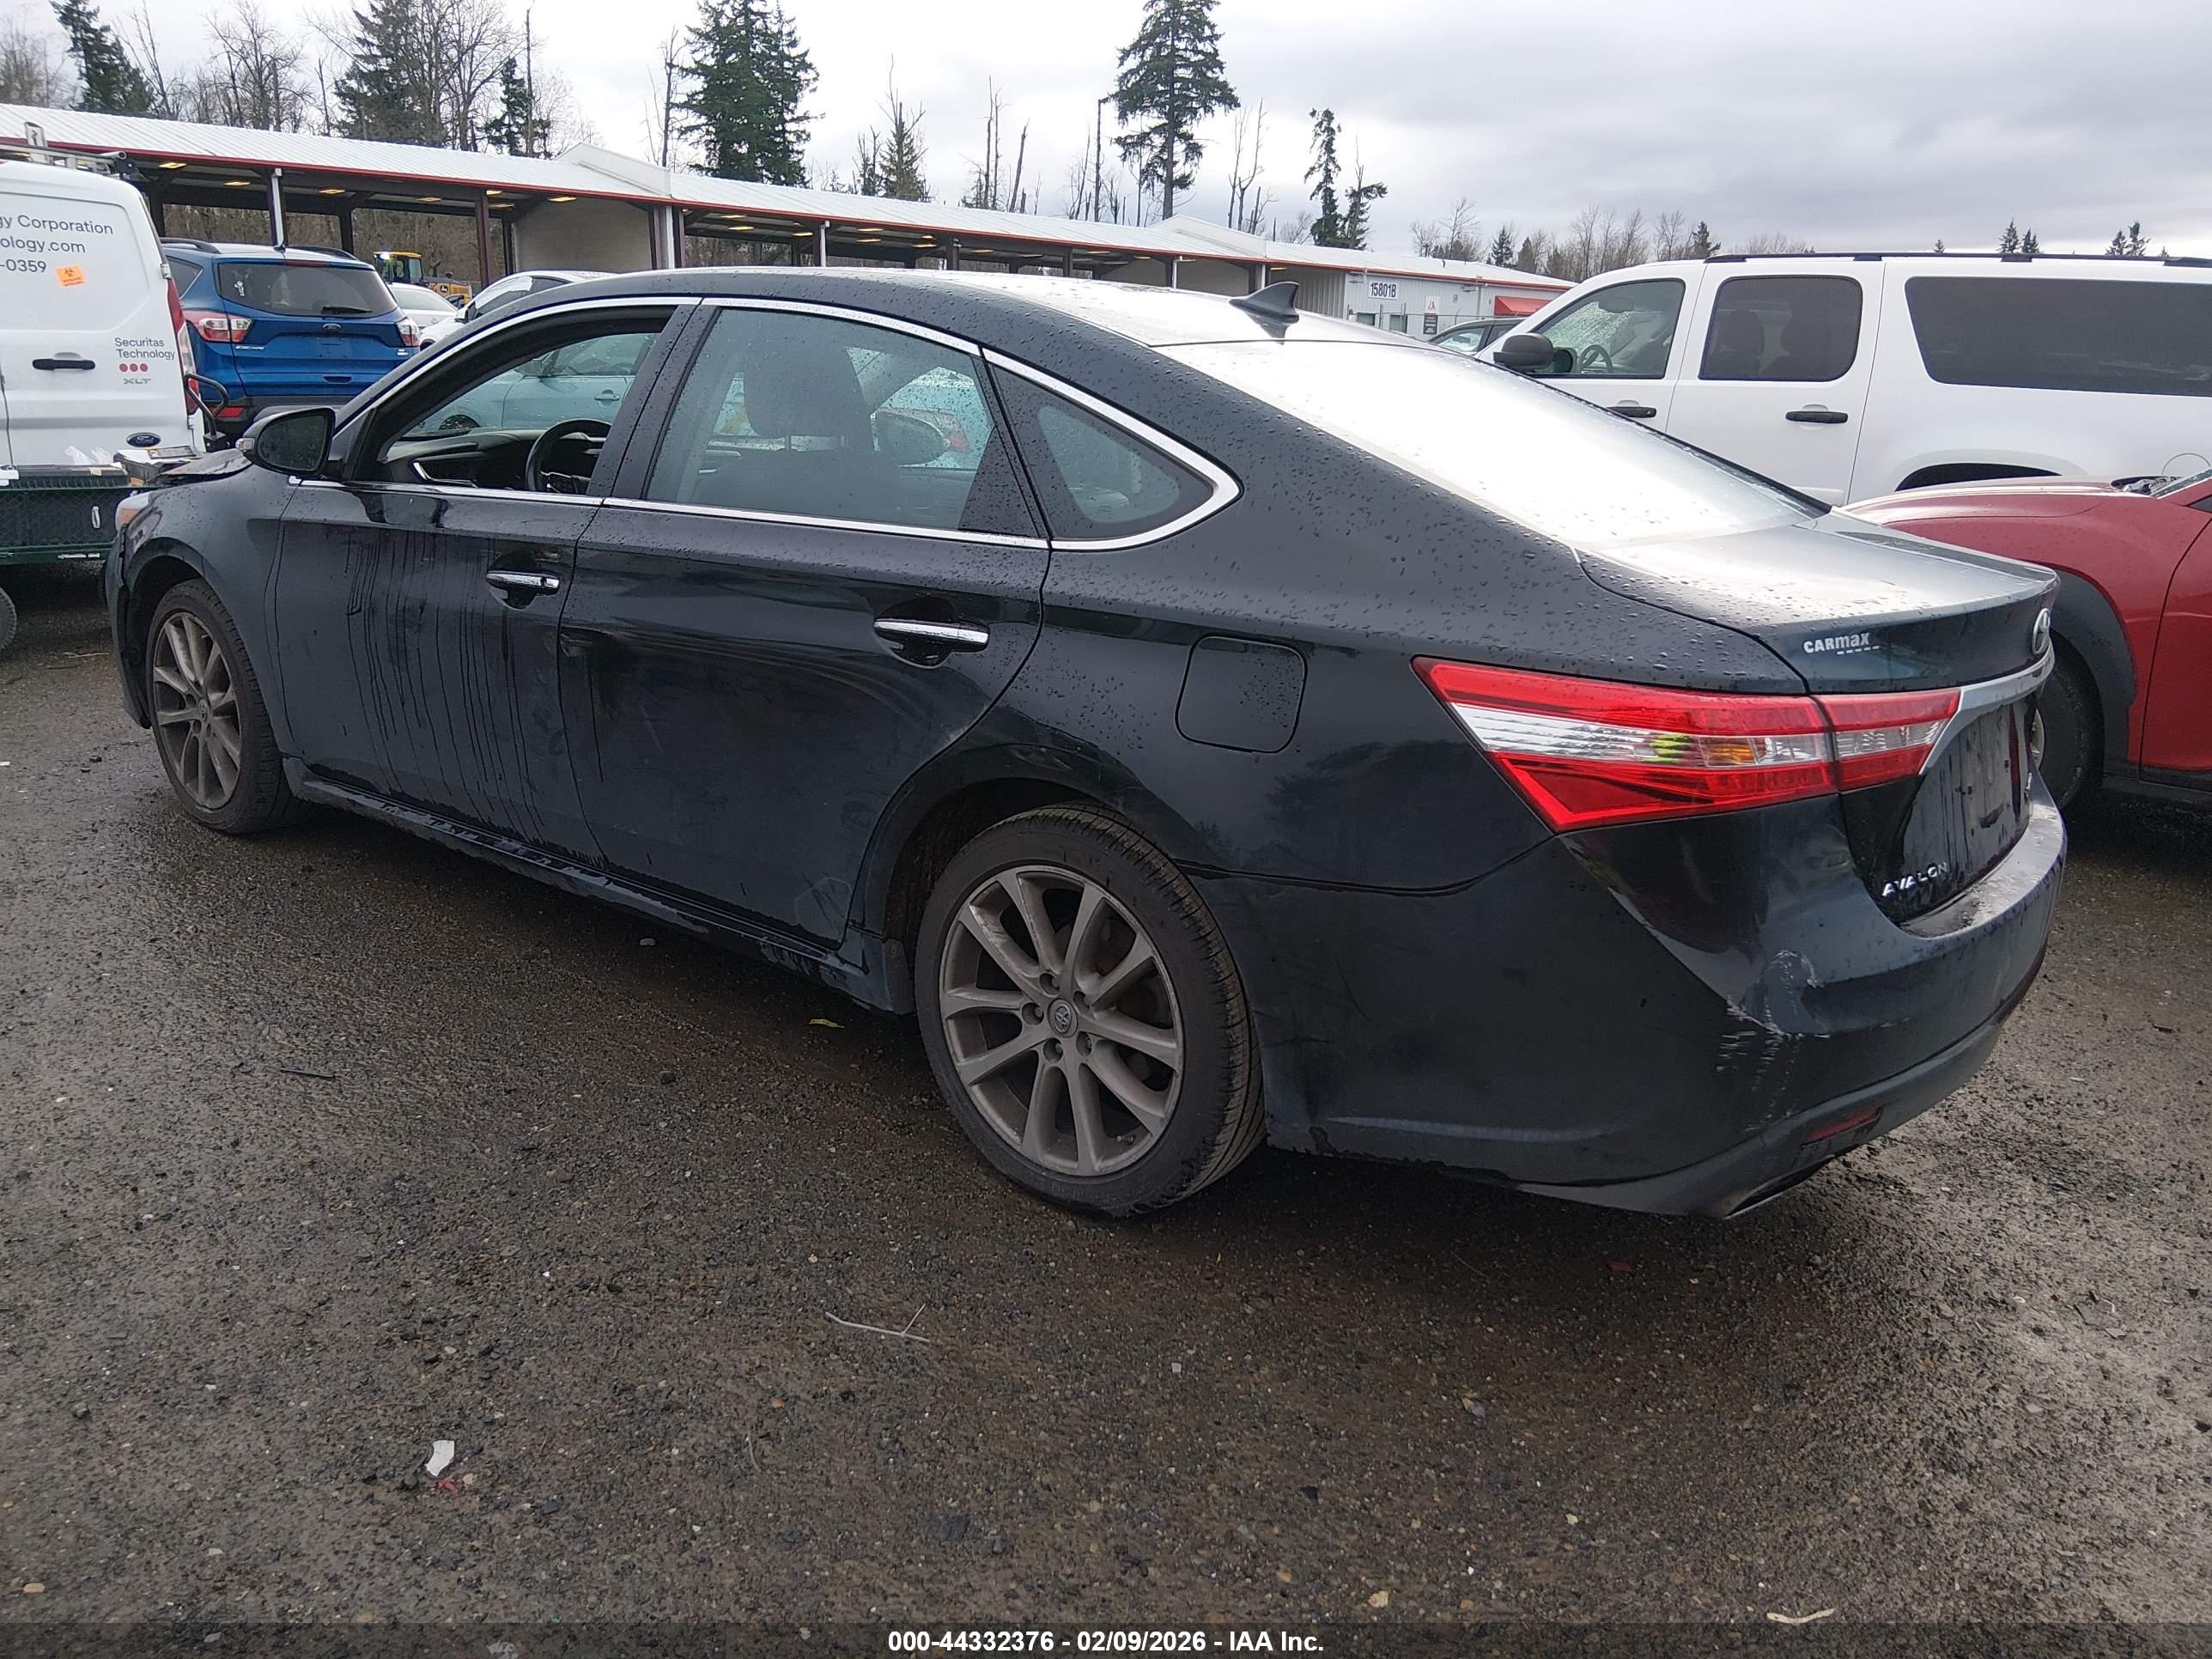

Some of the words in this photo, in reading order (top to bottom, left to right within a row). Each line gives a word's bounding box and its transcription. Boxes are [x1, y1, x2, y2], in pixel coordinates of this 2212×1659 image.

[17, 215, 113, 234] Corporation
[0, 235, 86, 253] ology.com
[0, 258, 46, 273] -0359
[1370, 283, 1397, 298] 15801B
[114, 337, 165, 347] Securitas
[116, 349, 175, 361] Technology
[1882, 862, 1948, 897] AVALON
